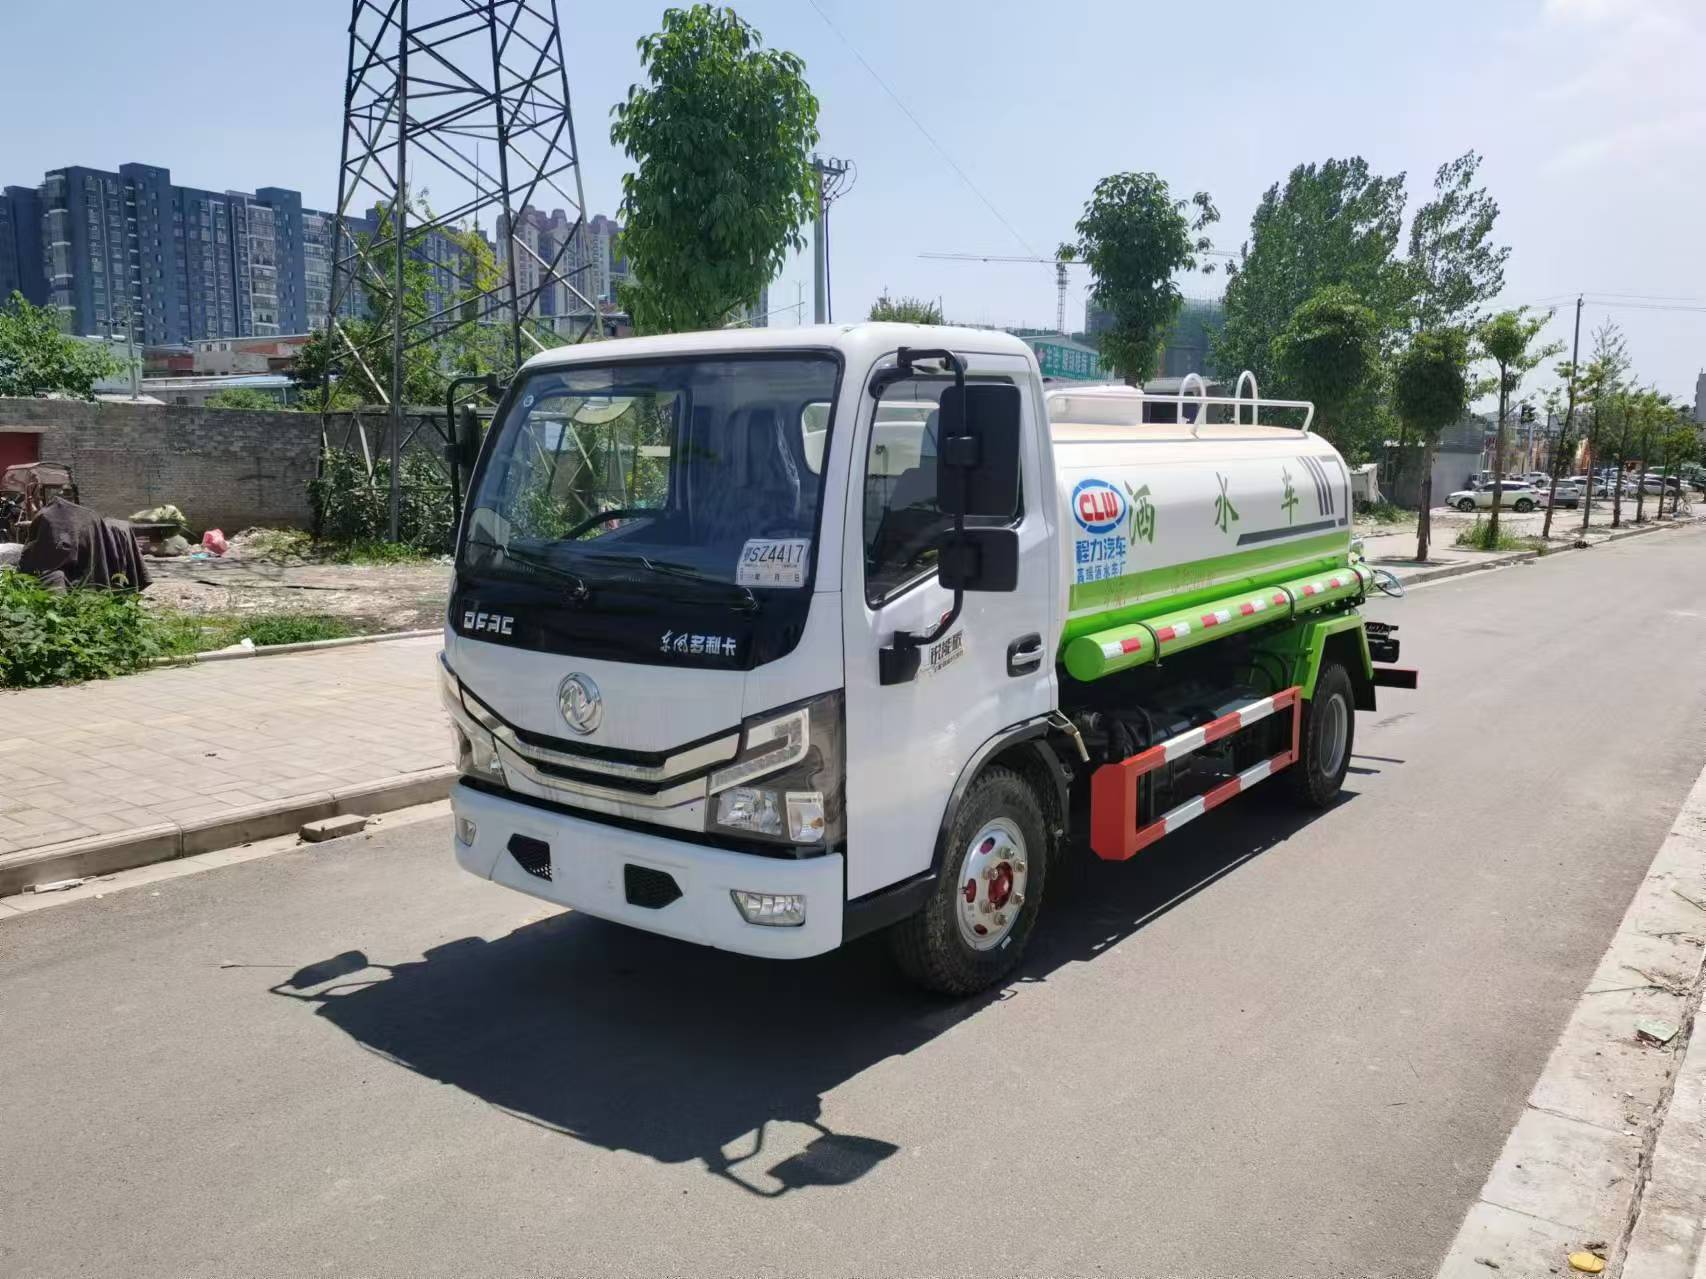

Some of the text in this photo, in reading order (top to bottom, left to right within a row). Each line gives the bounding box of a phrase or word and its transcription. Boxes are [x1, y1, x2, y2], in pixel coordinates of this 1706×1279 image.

[1079, 492, 1119, 522] CLW
[1076, 536, 1126, 565] 程力汽车
[464, 611, 514, 635] DFAC
